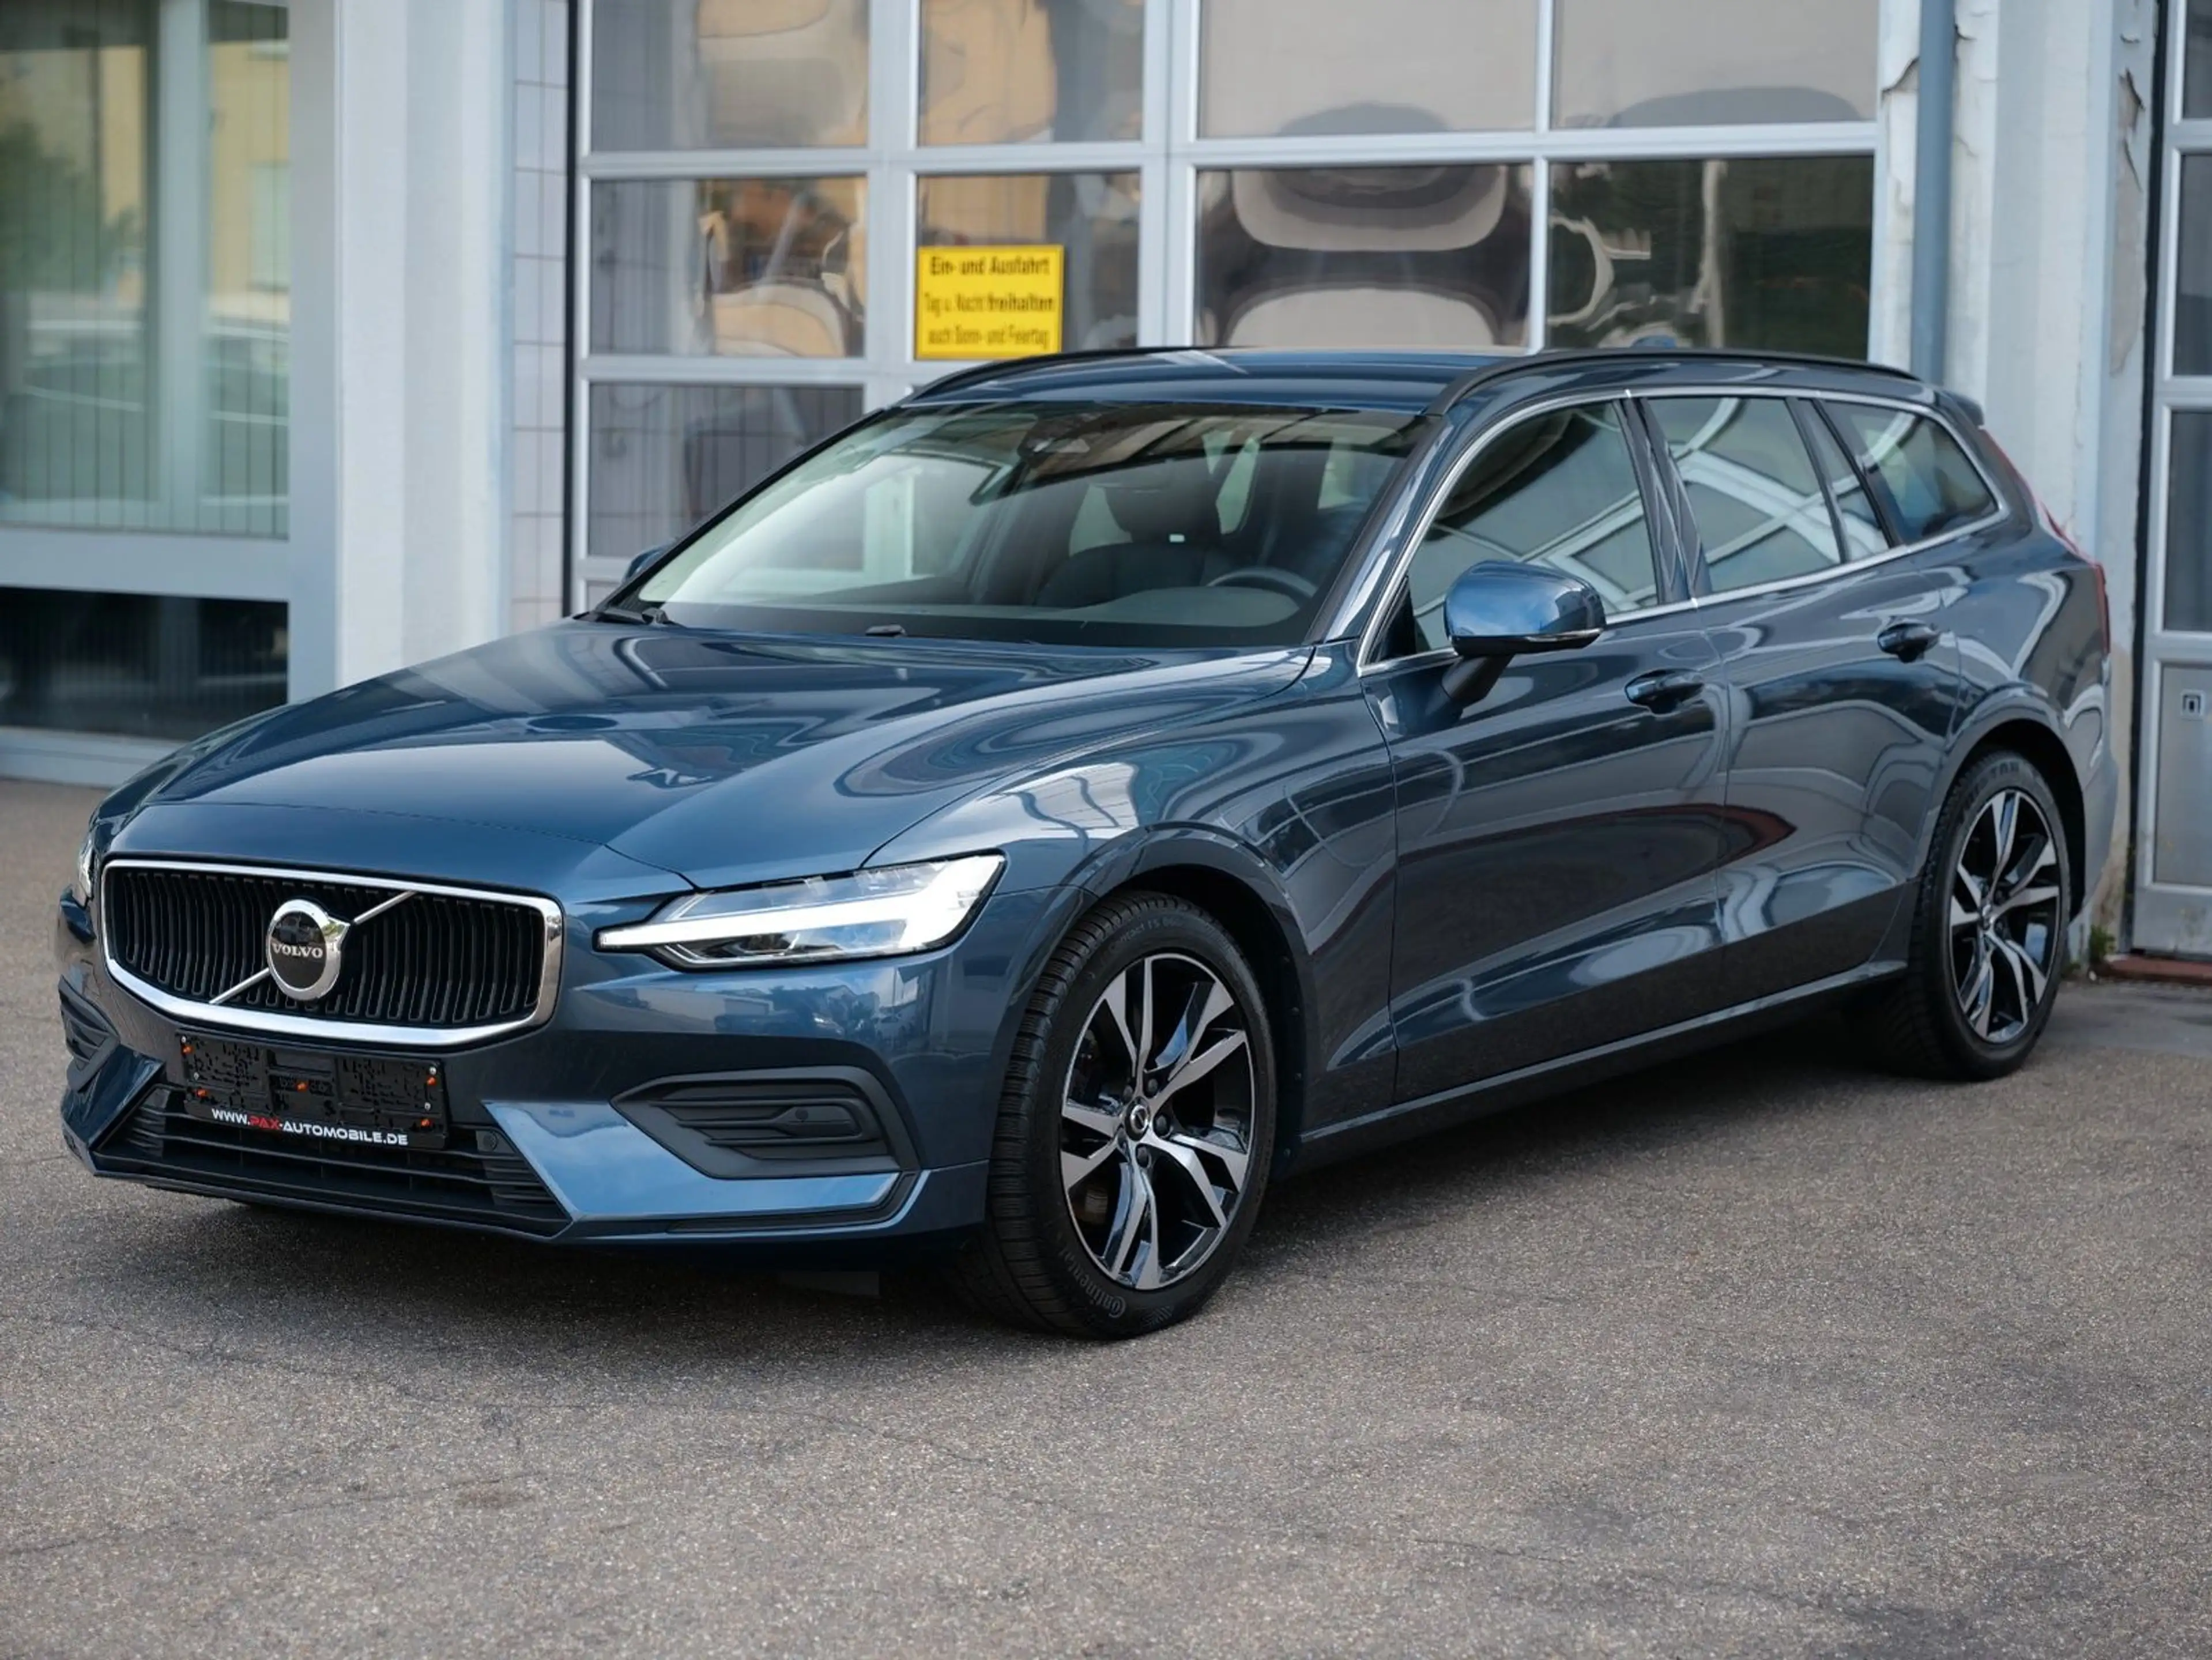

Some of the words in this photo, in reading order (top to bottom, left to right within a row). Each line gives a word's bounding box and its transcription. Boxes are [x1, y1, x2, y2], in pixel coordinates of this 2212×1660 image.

[930, 256, 957, 276] Ein-
[961, 256, 986, 275] und
[989, 255, 1050, 276] Ausfahrt
[986, 291, 1055, 312] freihalten
[272, 942, 323, 958] VOLVO
[212, 1108, 409, 1145] WWW.PAX-AUTOMOBILE.DE
